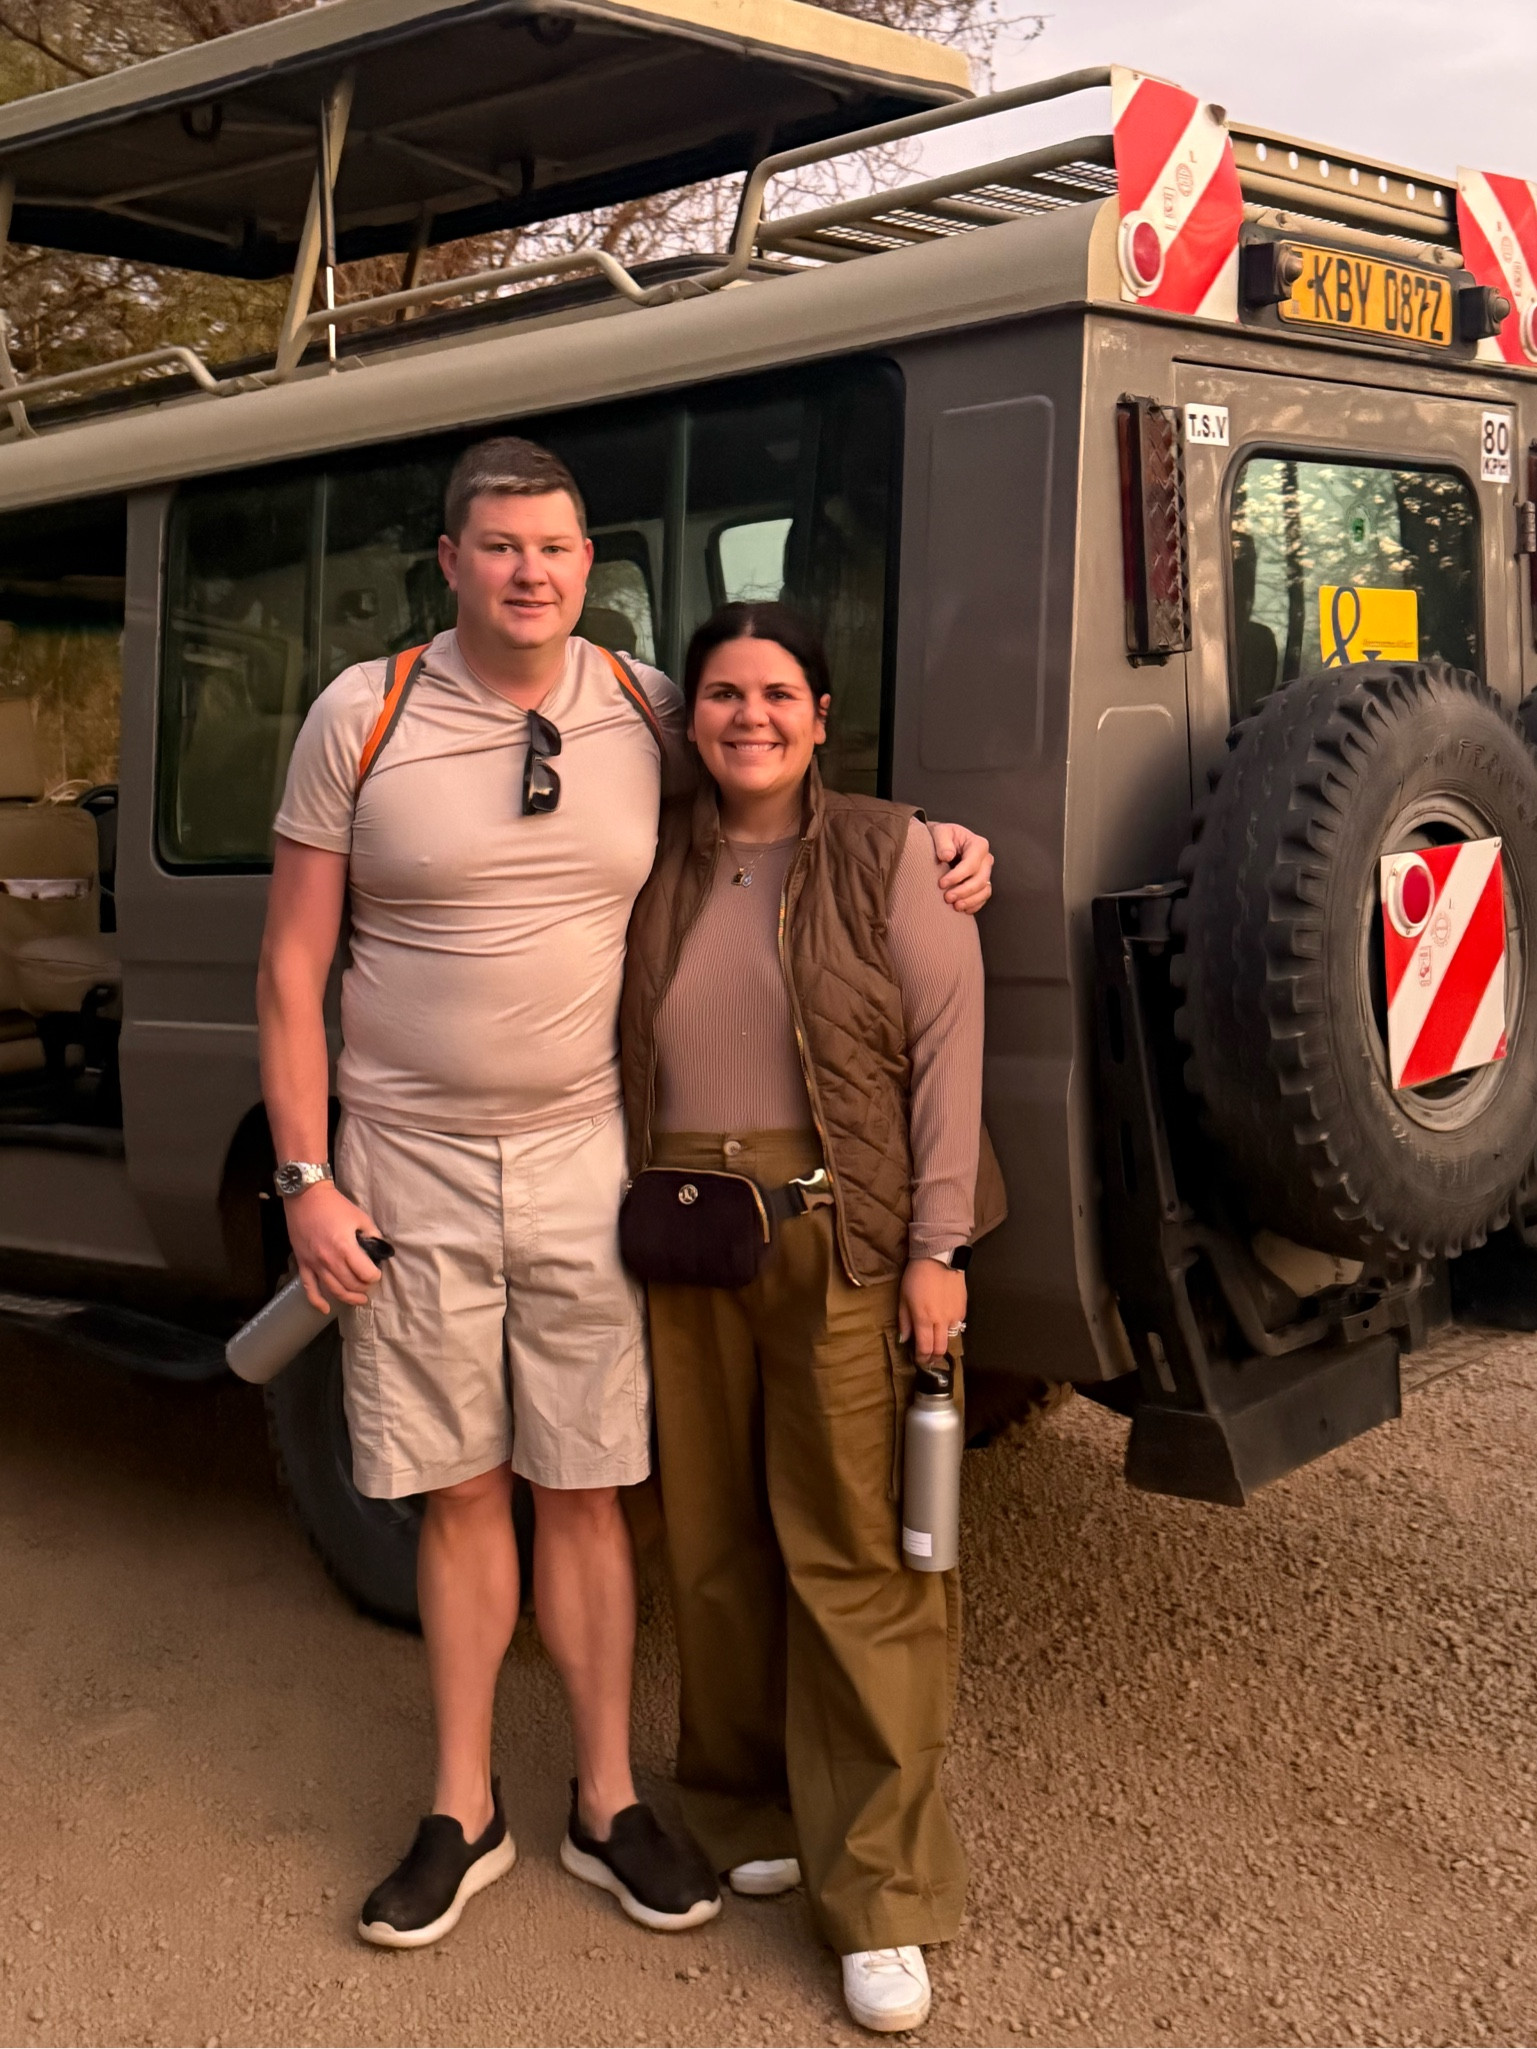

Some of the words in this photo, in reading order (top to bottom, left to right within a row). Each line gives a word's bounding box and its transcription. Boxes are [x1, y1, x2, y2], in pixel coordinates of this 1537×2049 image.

[1314, 254, 1371, 325] KBY
[1384, 268, 1443, 341] 087Z
[1484, 420, 1508, 455] 80
